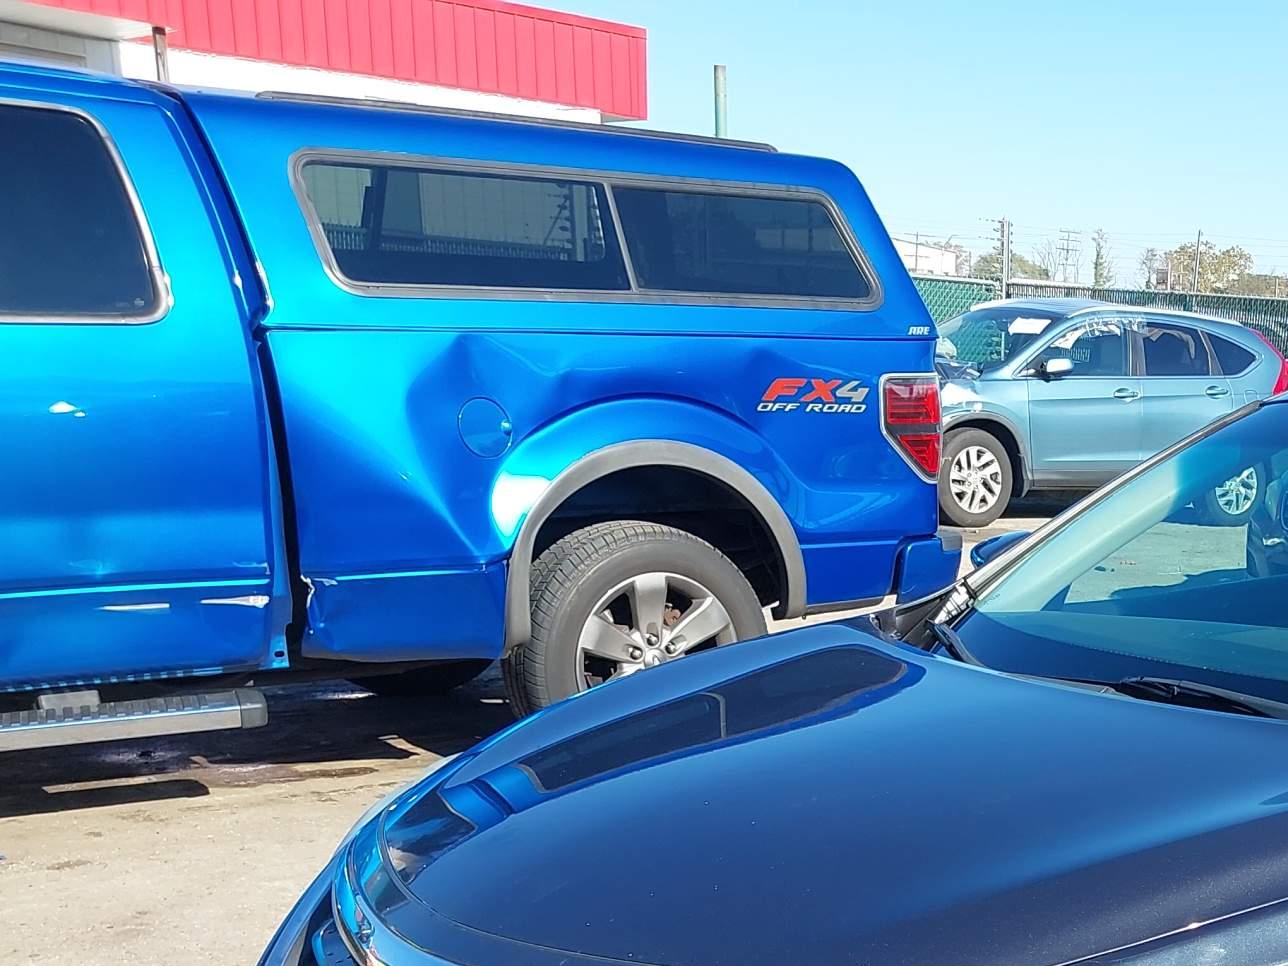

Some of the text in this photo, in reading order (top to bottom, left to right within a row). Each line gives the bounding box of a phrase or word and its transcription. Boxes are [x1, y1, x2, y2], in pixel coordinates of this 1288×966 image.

[907, 326, 930, 336] ARE
[761, 377, 870, 402] FX4
[757, 402, 868, 413] OFF ROAD
